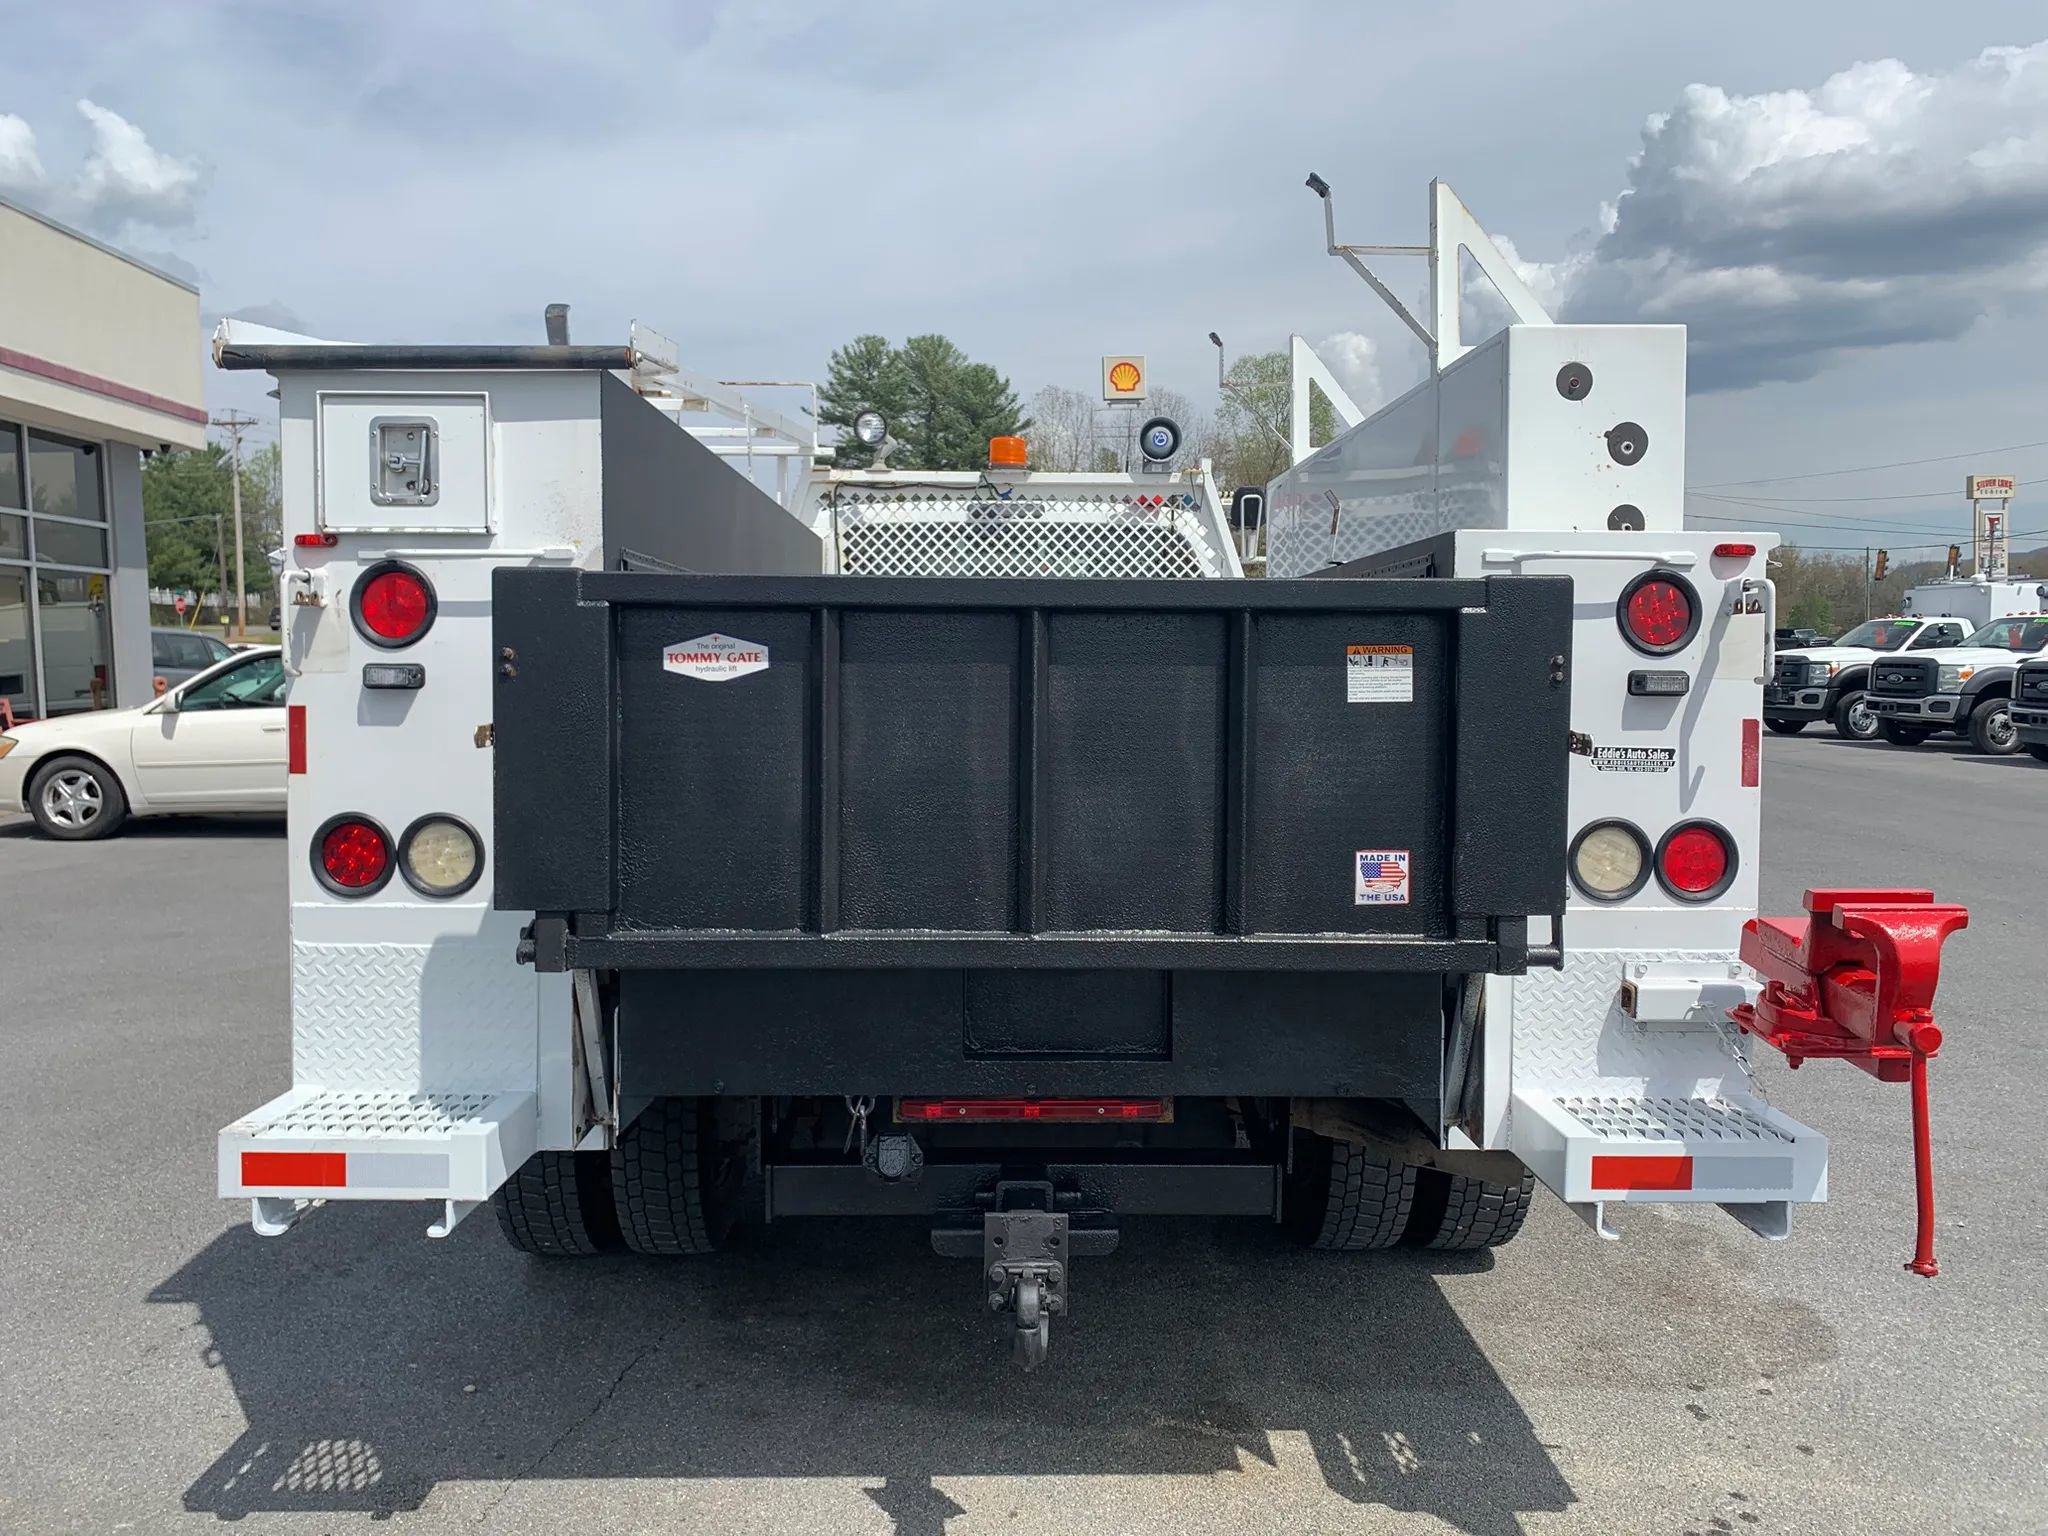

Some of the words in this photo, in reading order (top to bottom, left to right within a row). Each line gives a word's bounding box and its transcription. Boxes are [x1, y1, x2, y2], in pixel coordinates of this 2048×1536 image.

[711, 643, 736, 651] original
[1362, 646, 1408, 654] WARNING
[667, 652, 721, 663] TOMMY
[727, 652, 762, 663] GATE
[695, 665, 727, 673] hydraulic
[1597, 747, 1626, 758] Eddie's
[1626, 748, 1647, 759] Auto
[1647, 748, 1670, 760] Sales
[1360, 854, 1391, 862] MADE
[1394, 854, 1406, 862] IN
[1360, 893, 1381, 901] THE
[1384, 893, 1406, 901] USA
